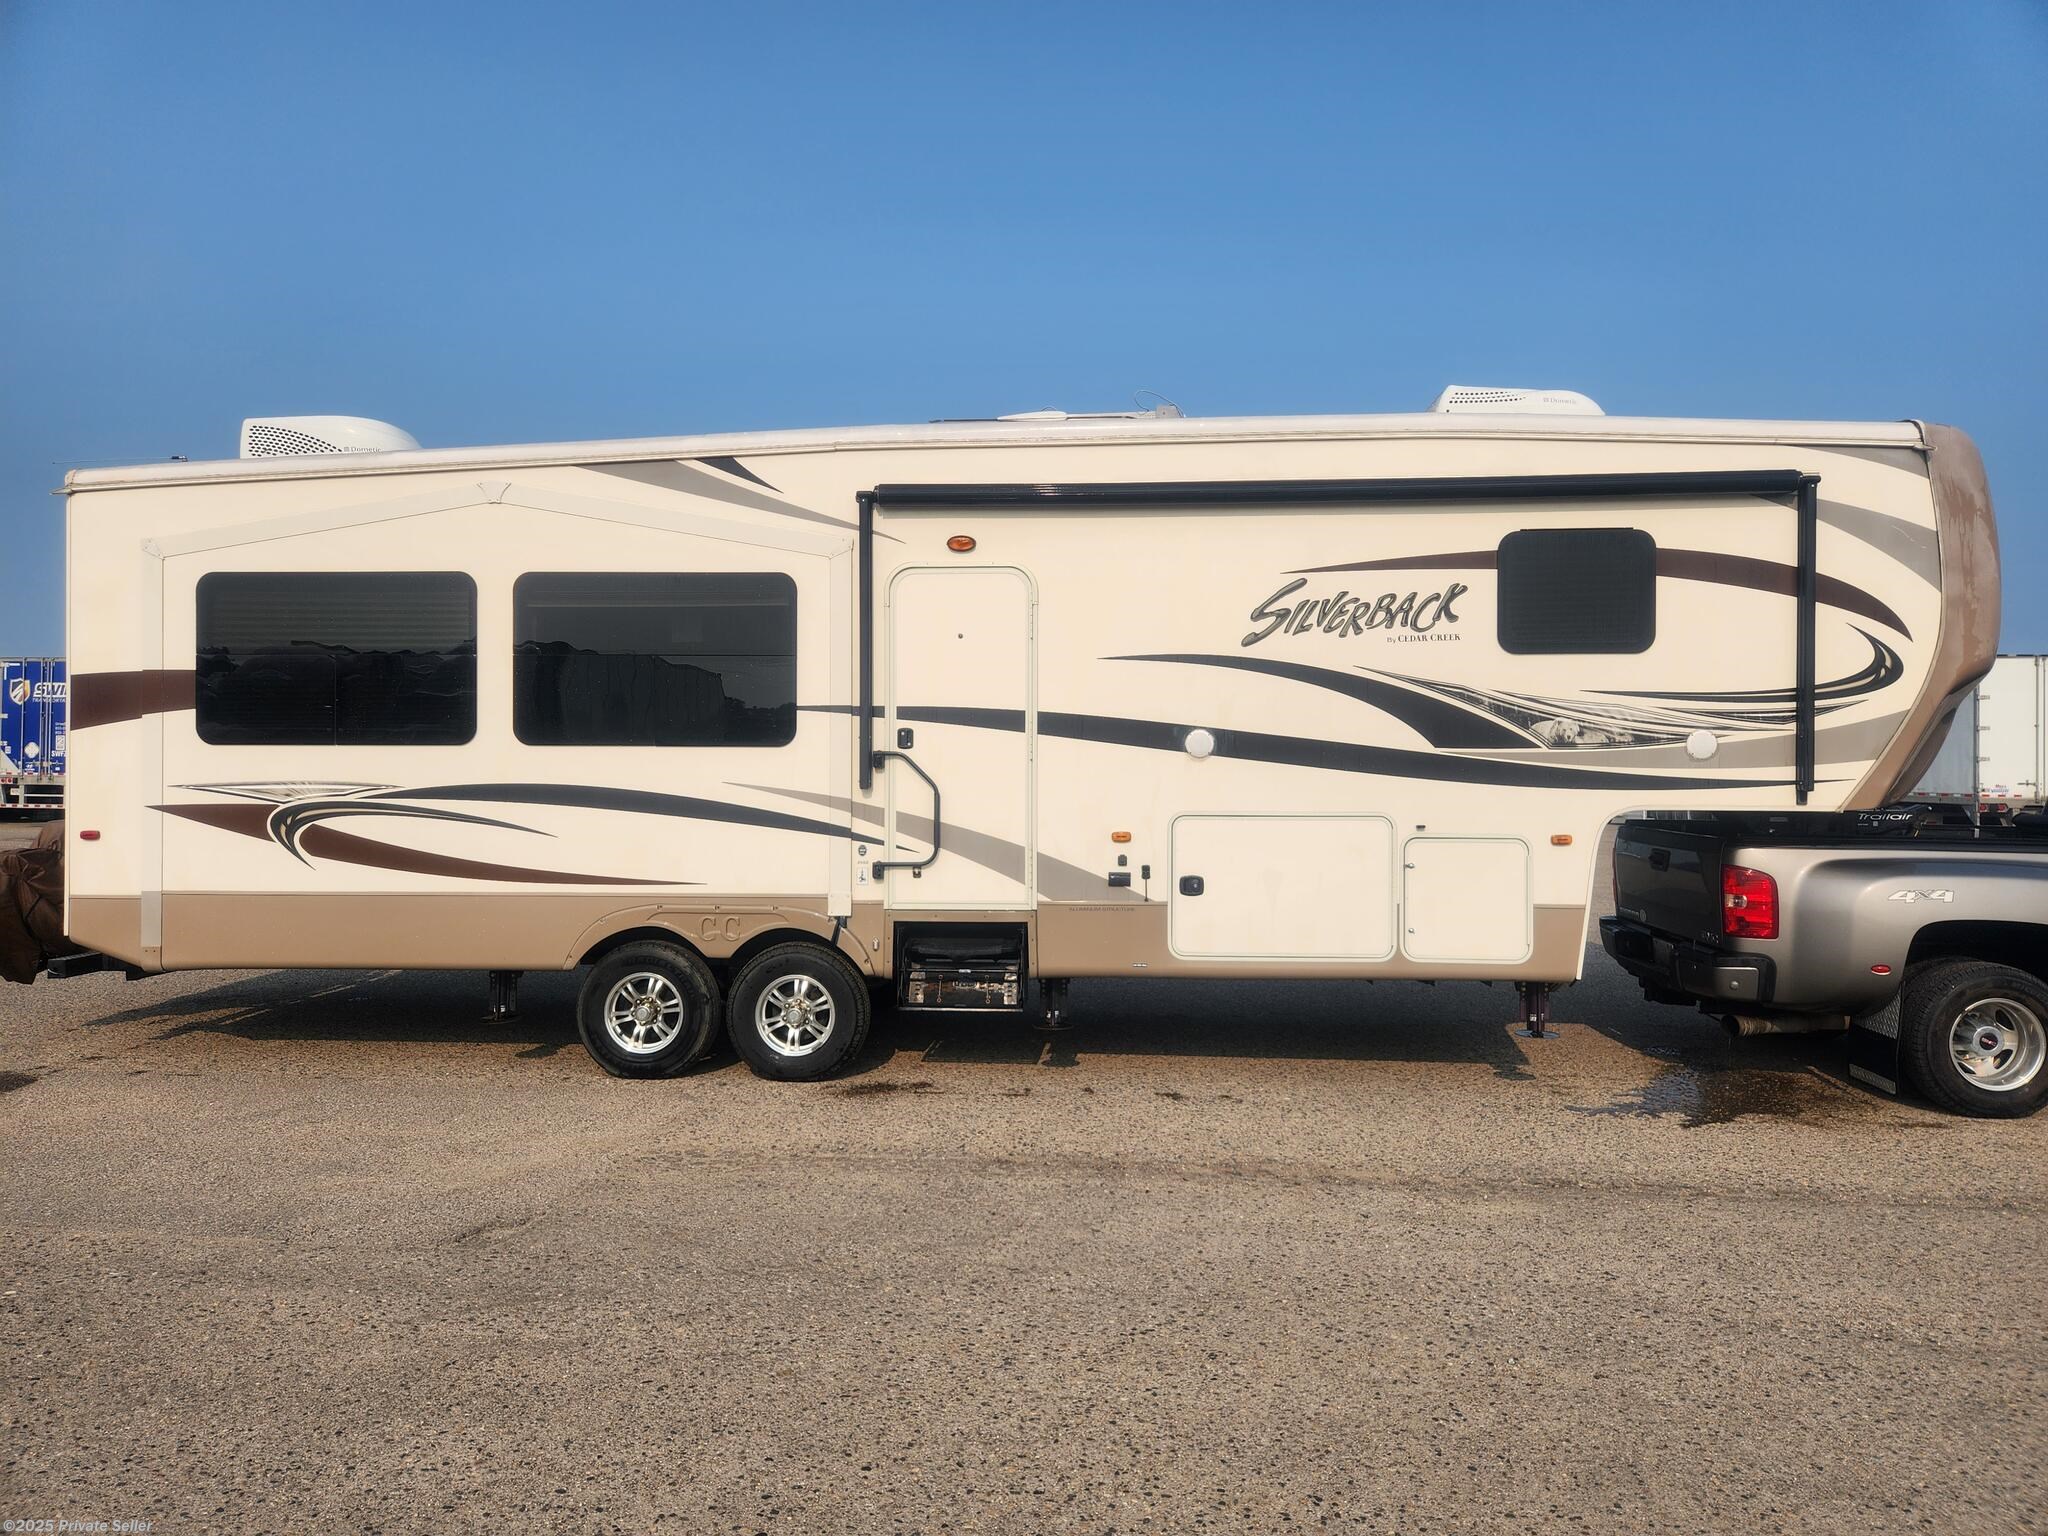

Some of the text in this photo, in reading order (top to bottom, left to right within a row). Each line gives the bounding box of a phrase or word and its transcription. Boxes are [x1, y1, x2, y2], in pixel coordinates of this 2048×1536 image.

[1240, 577, 1469, 648] SILVERBACK
[1398, 634, 1428, 643] CEDAR
[1430, 633, 1461, 642] CREEK
